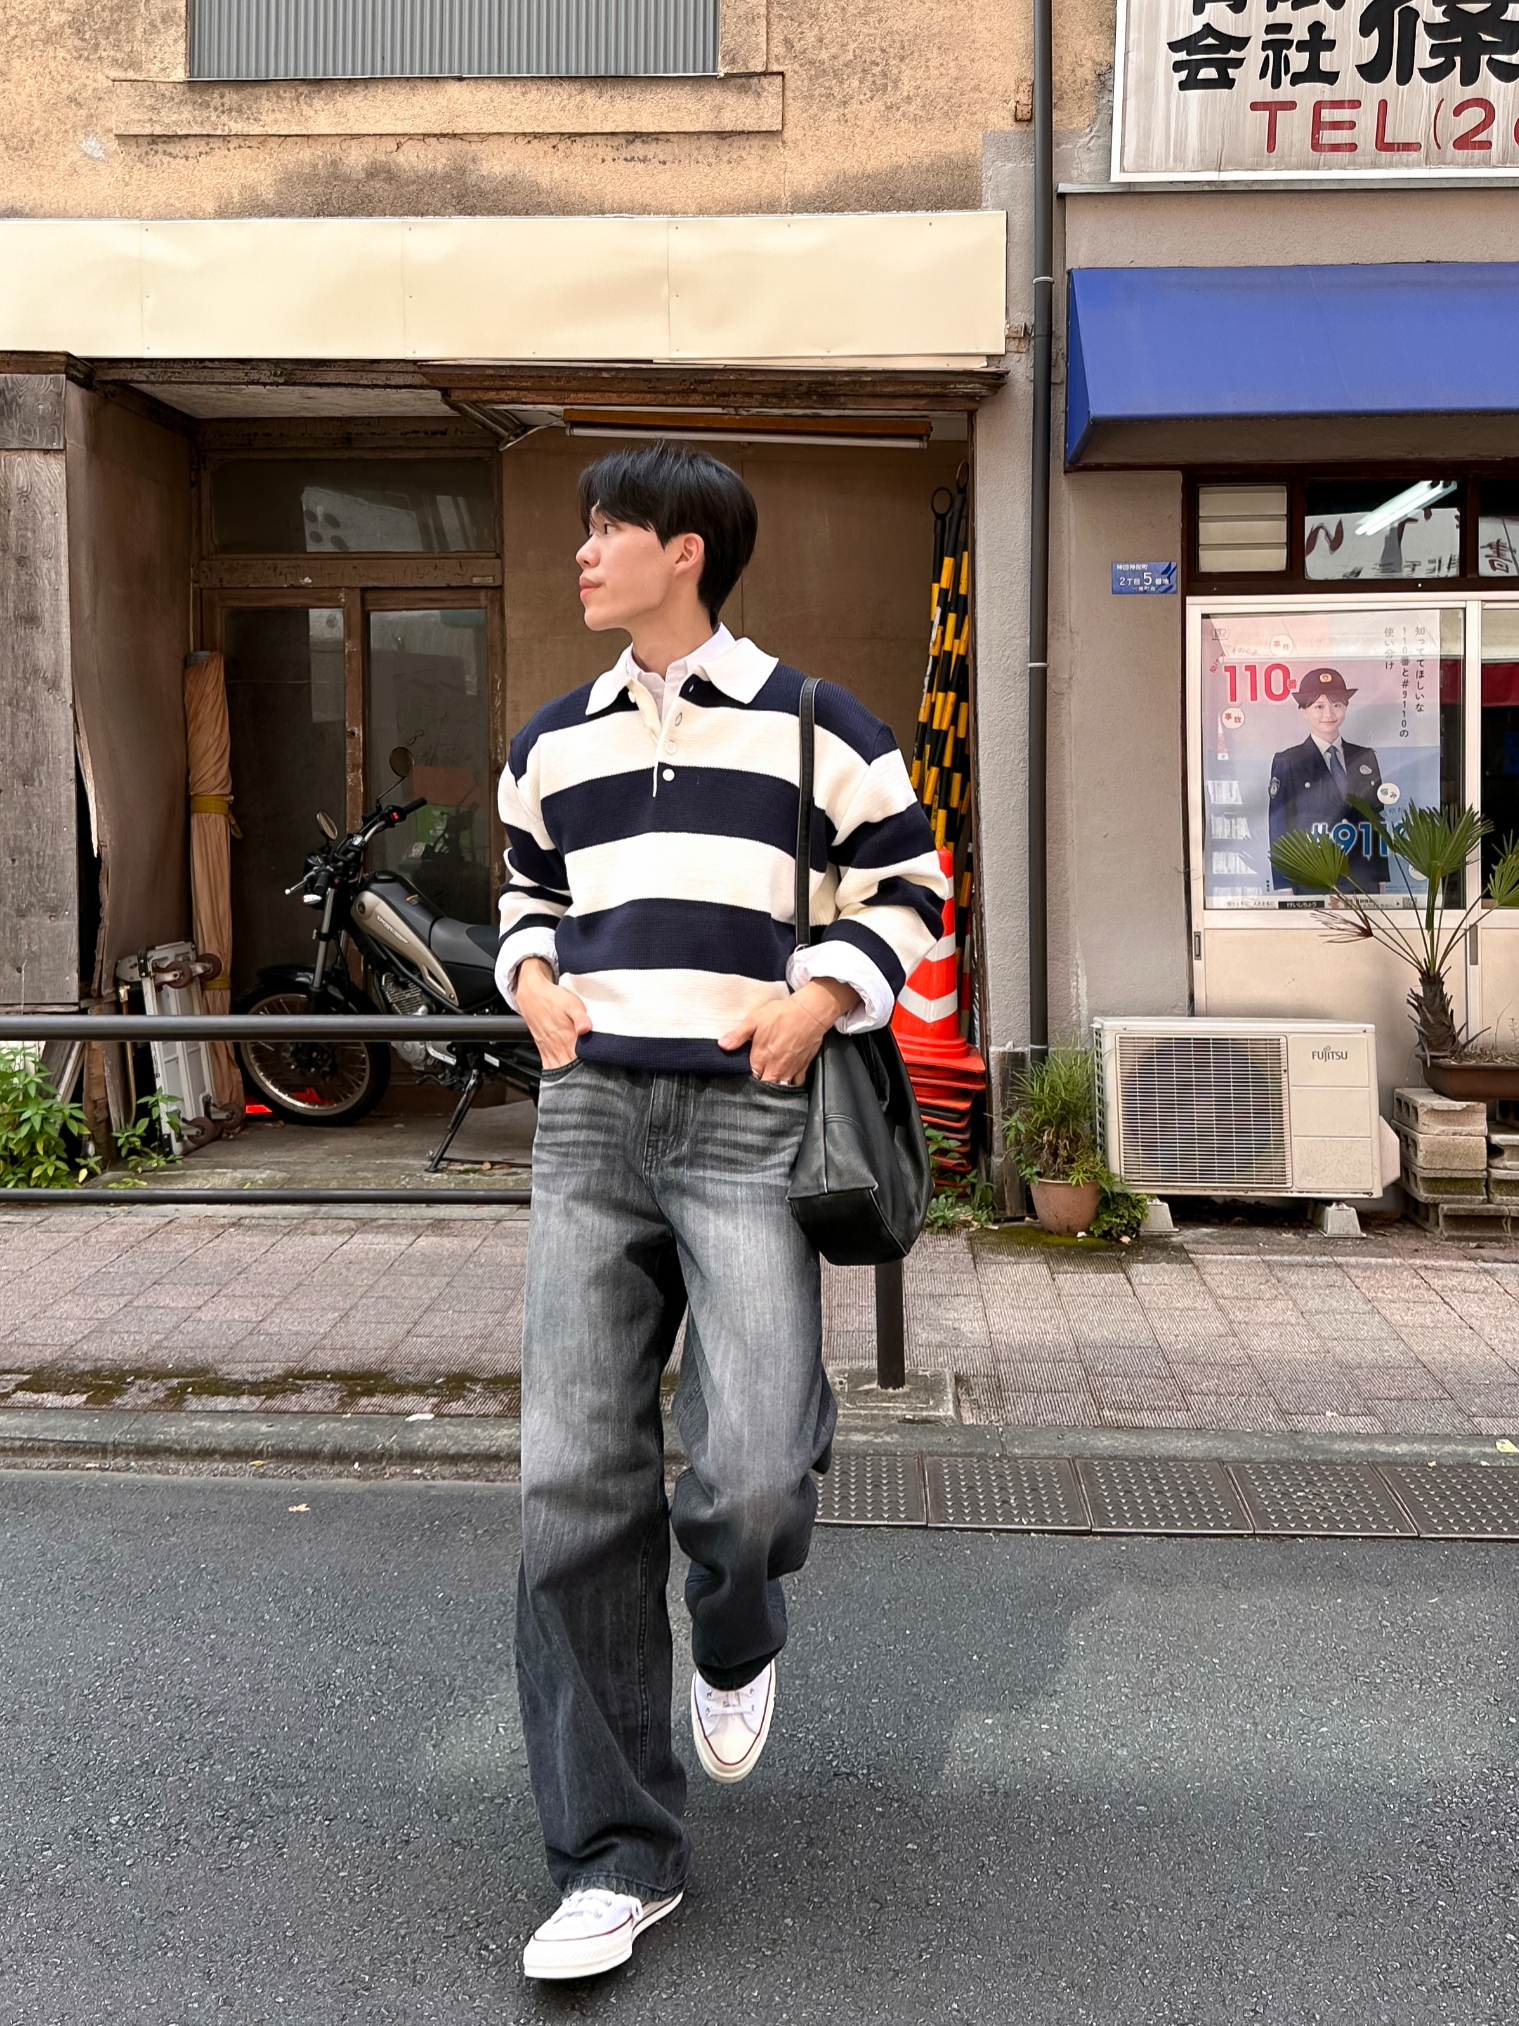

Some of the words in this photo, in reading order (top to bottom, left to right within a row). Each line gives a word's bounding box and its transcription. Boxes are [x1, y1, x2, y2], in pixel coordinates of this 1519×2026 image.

[1166, 20, 1341, 91] 会社
[1249, 97, 1519, 154] TEL(2
[1384, 627, 1395, 671] 使い分け
[1415, 627, 1426, 713] 知っててほしいな
[1399, 626, 1411, 739] 110番と#9110の
[1311, 1049, 1348, 1063] FUJITSU
